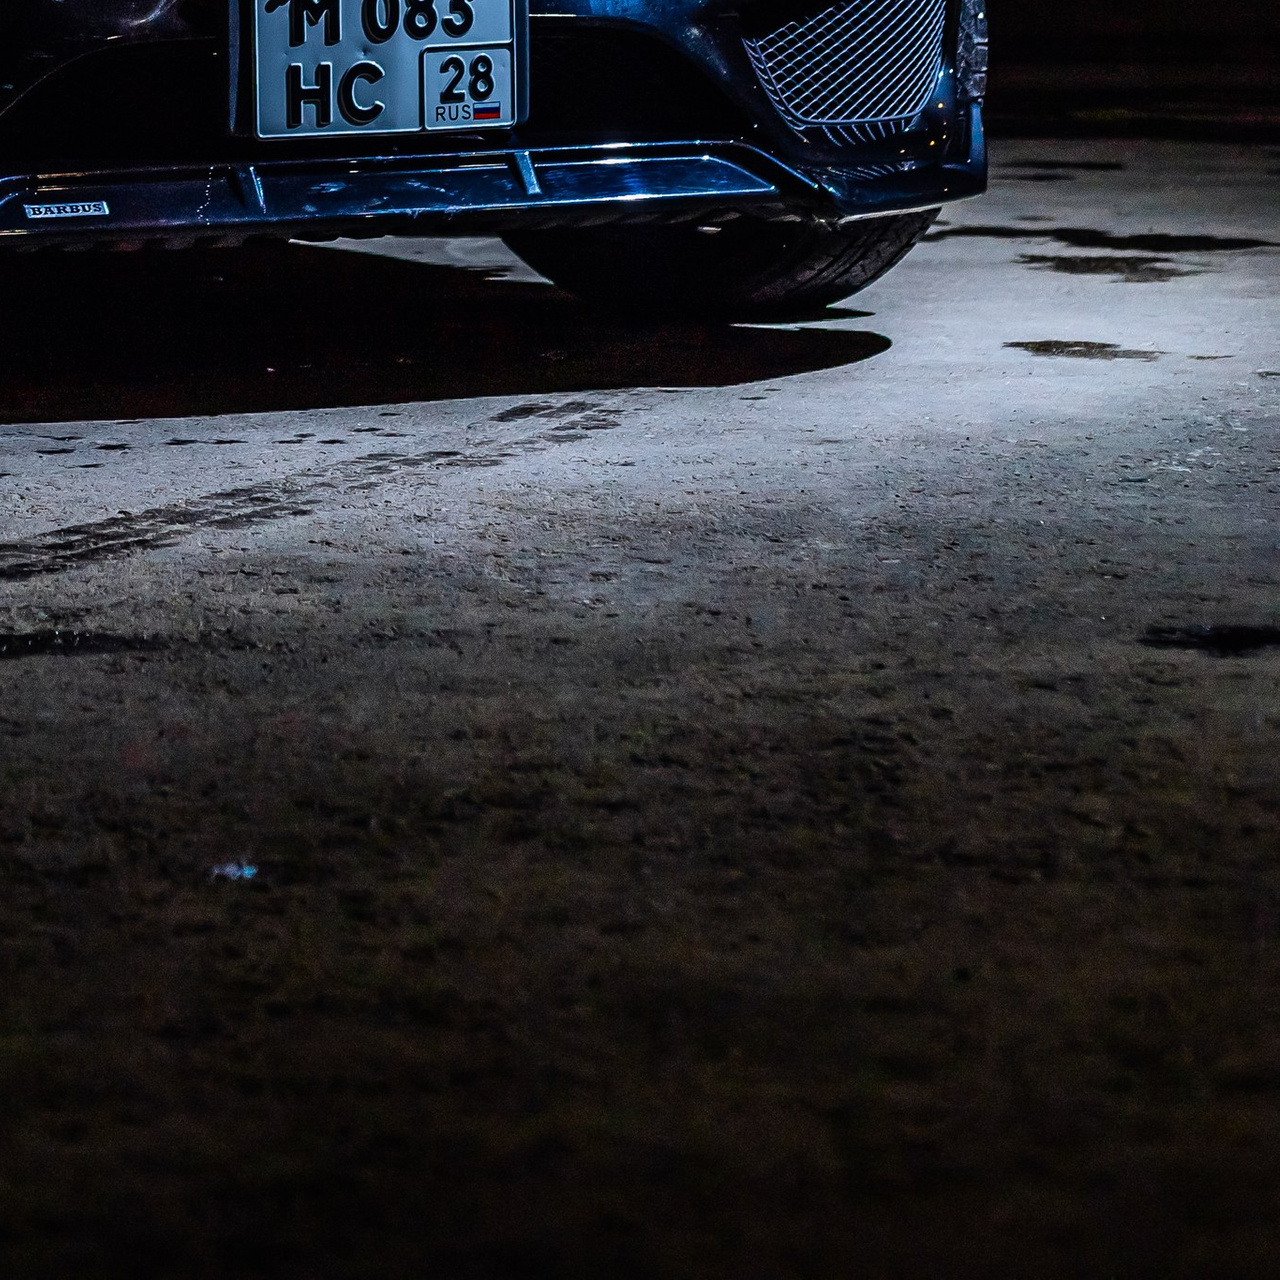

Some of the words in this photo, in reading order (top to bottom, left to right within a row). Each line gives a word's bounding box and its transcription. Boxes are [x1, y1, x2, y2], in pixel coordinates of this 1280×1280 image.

[439, 53, 495, 104] 28
[435, 104, 471, 122] RUS
[30, 203, 102, 216] BARBUS
